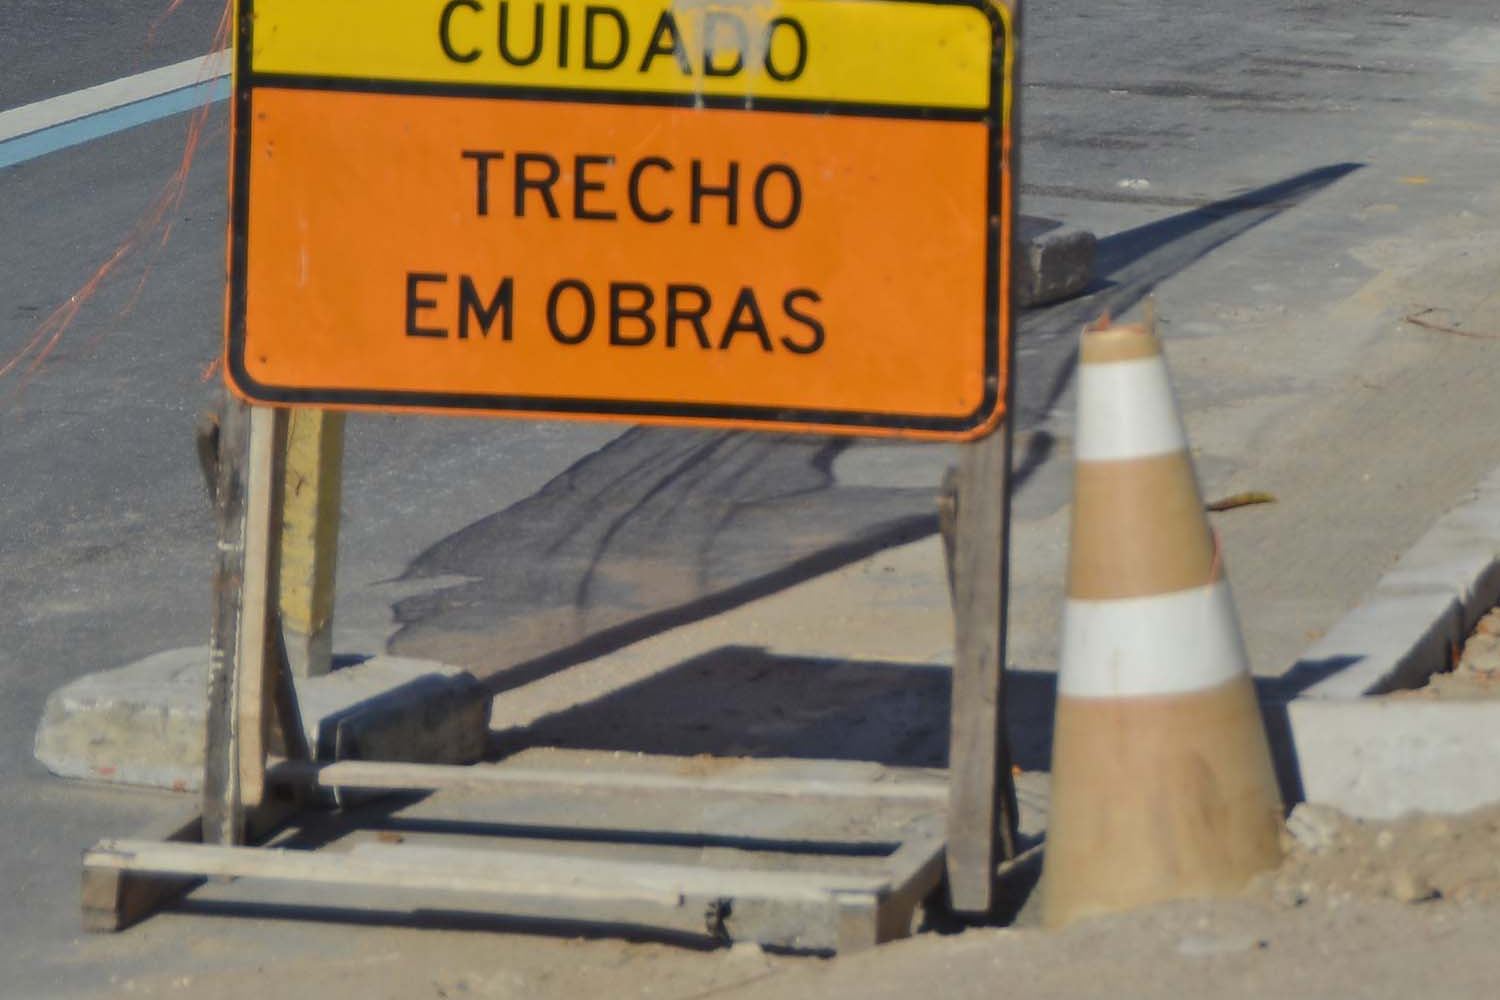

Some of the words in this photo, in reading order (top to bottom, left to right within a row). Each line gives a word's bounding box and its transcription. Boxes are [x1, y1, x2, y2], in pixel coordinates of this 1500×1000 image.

[461, 150, 803, 230] TRECHO
[405, 271, 514, 341] EM
[546, 279, 827, 356] OBRAS
